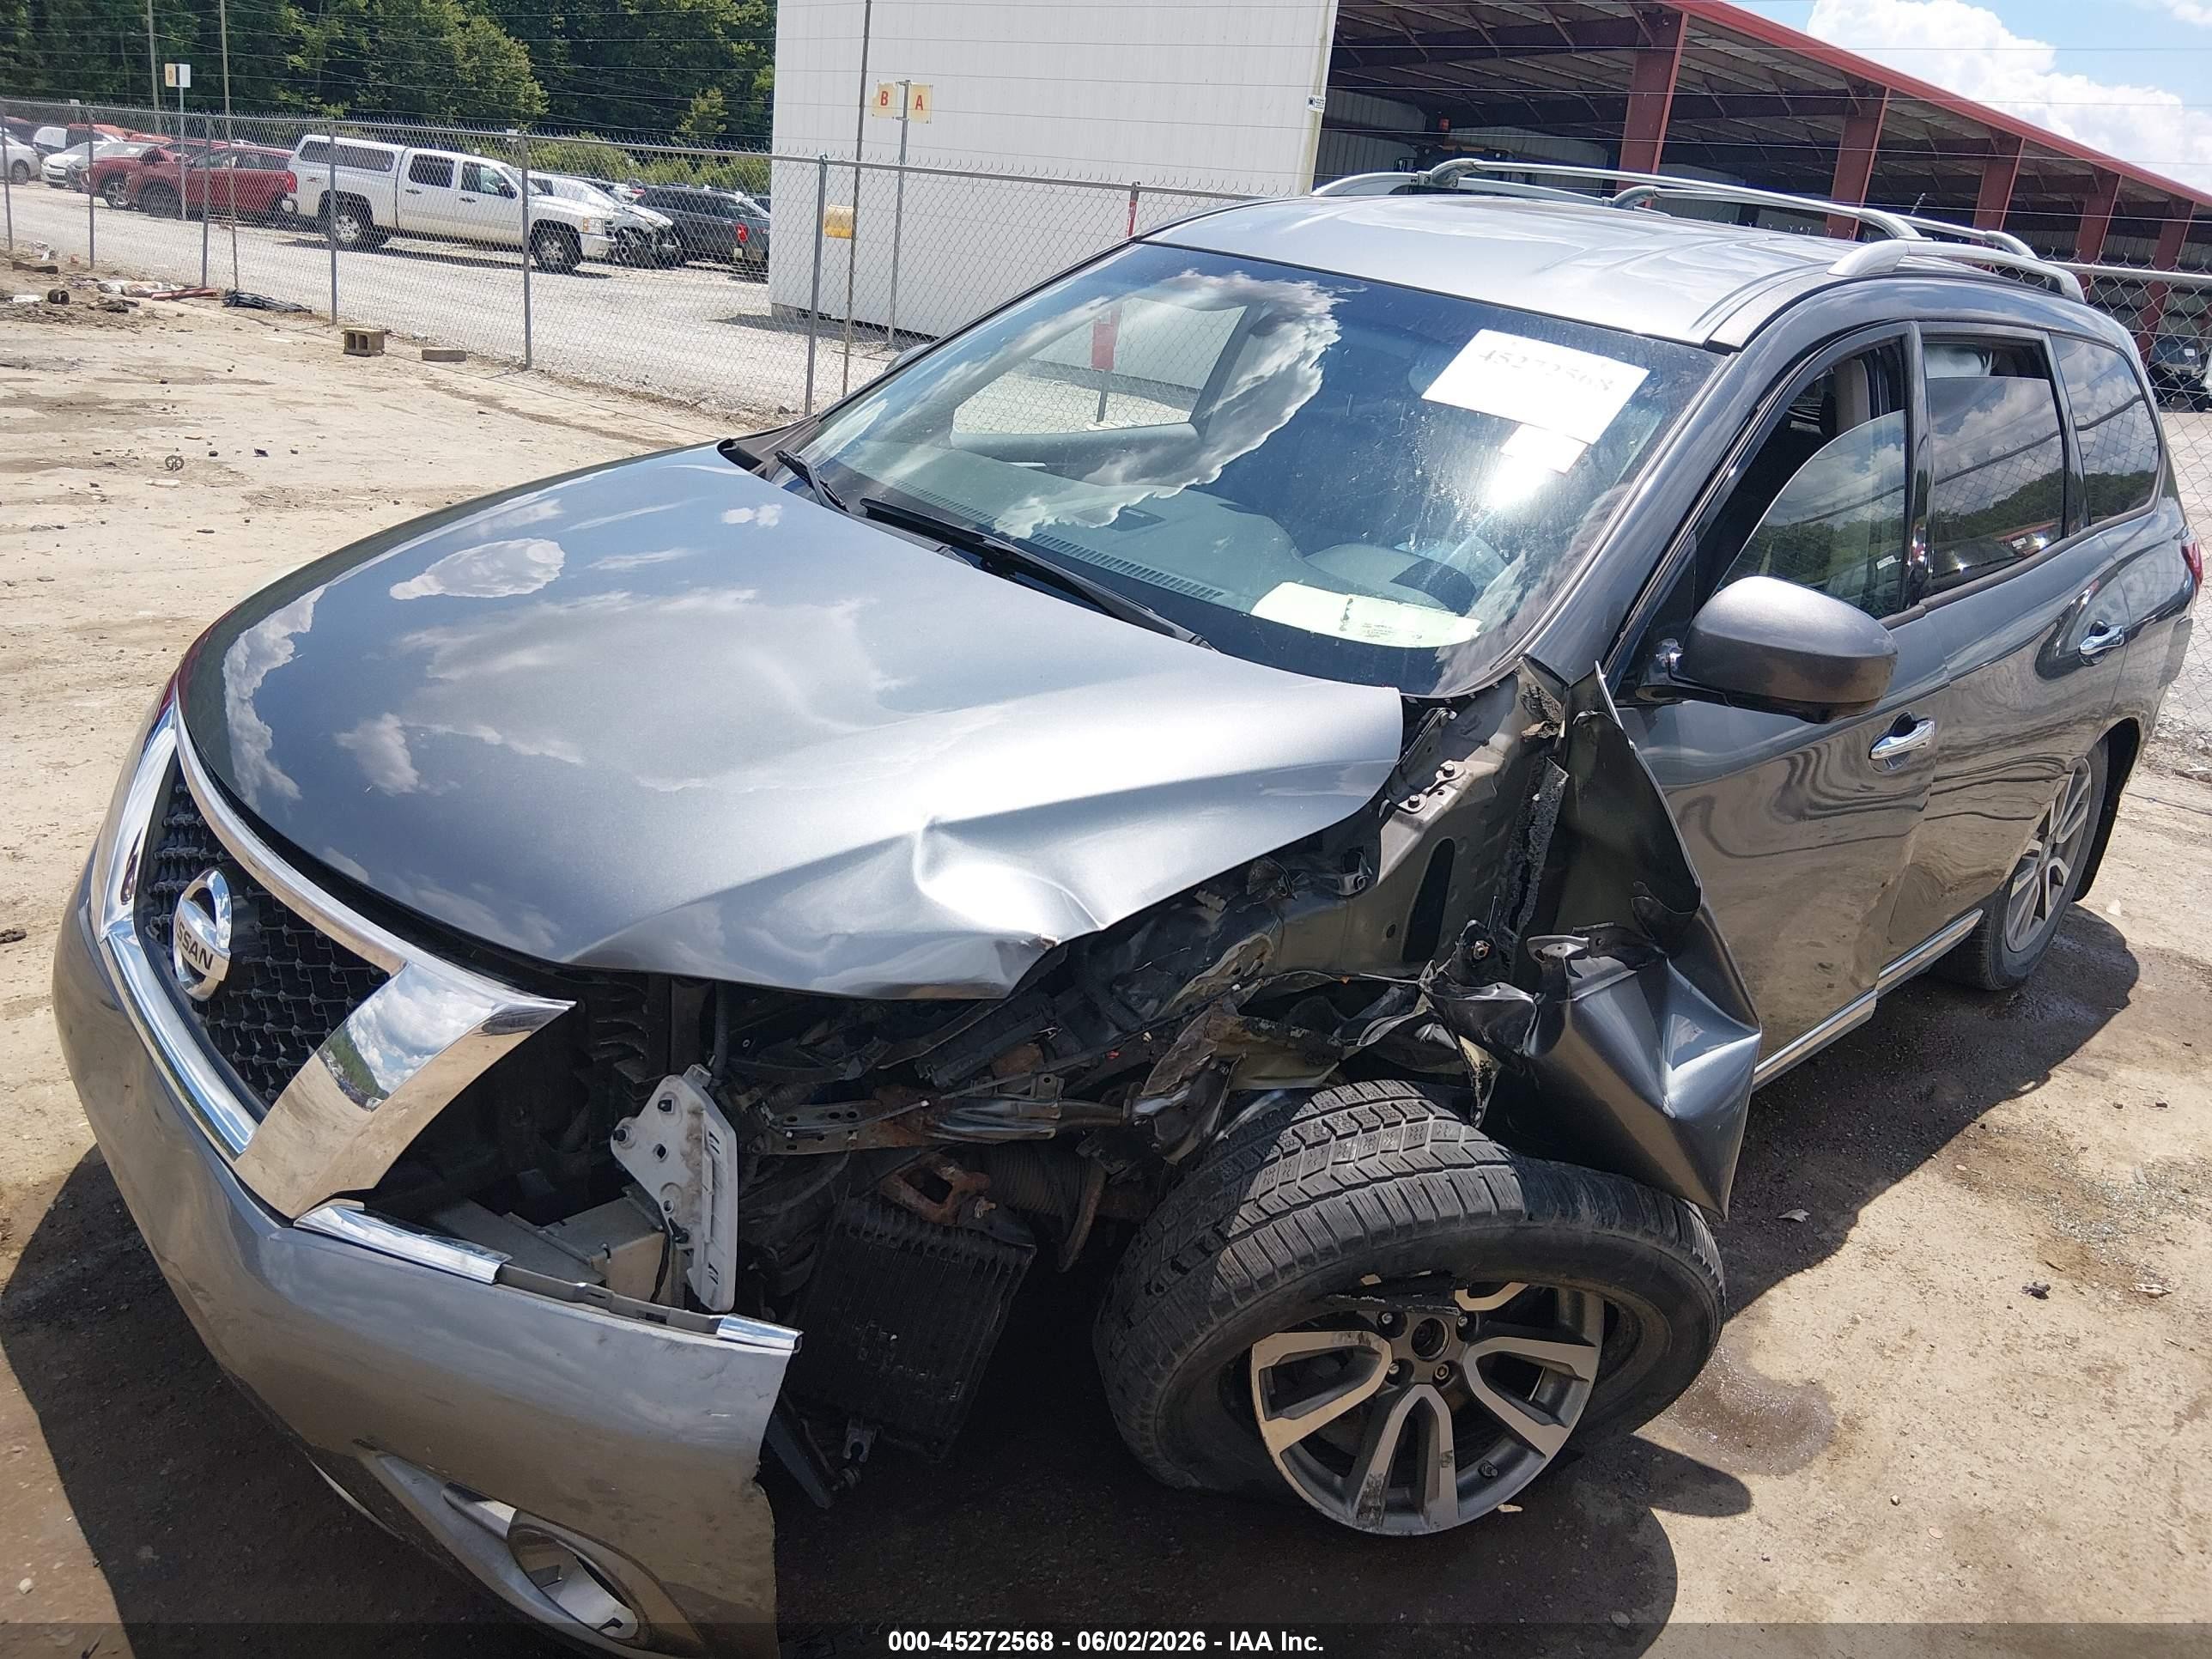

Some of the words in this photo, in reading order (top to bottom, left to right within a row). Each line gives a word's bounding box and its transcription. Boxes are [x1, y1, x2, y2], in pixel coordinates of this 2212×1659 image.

[168, 70, 173, 80] D
[880, 90, 889, 106] B
[915, 94, 923, 110] A
